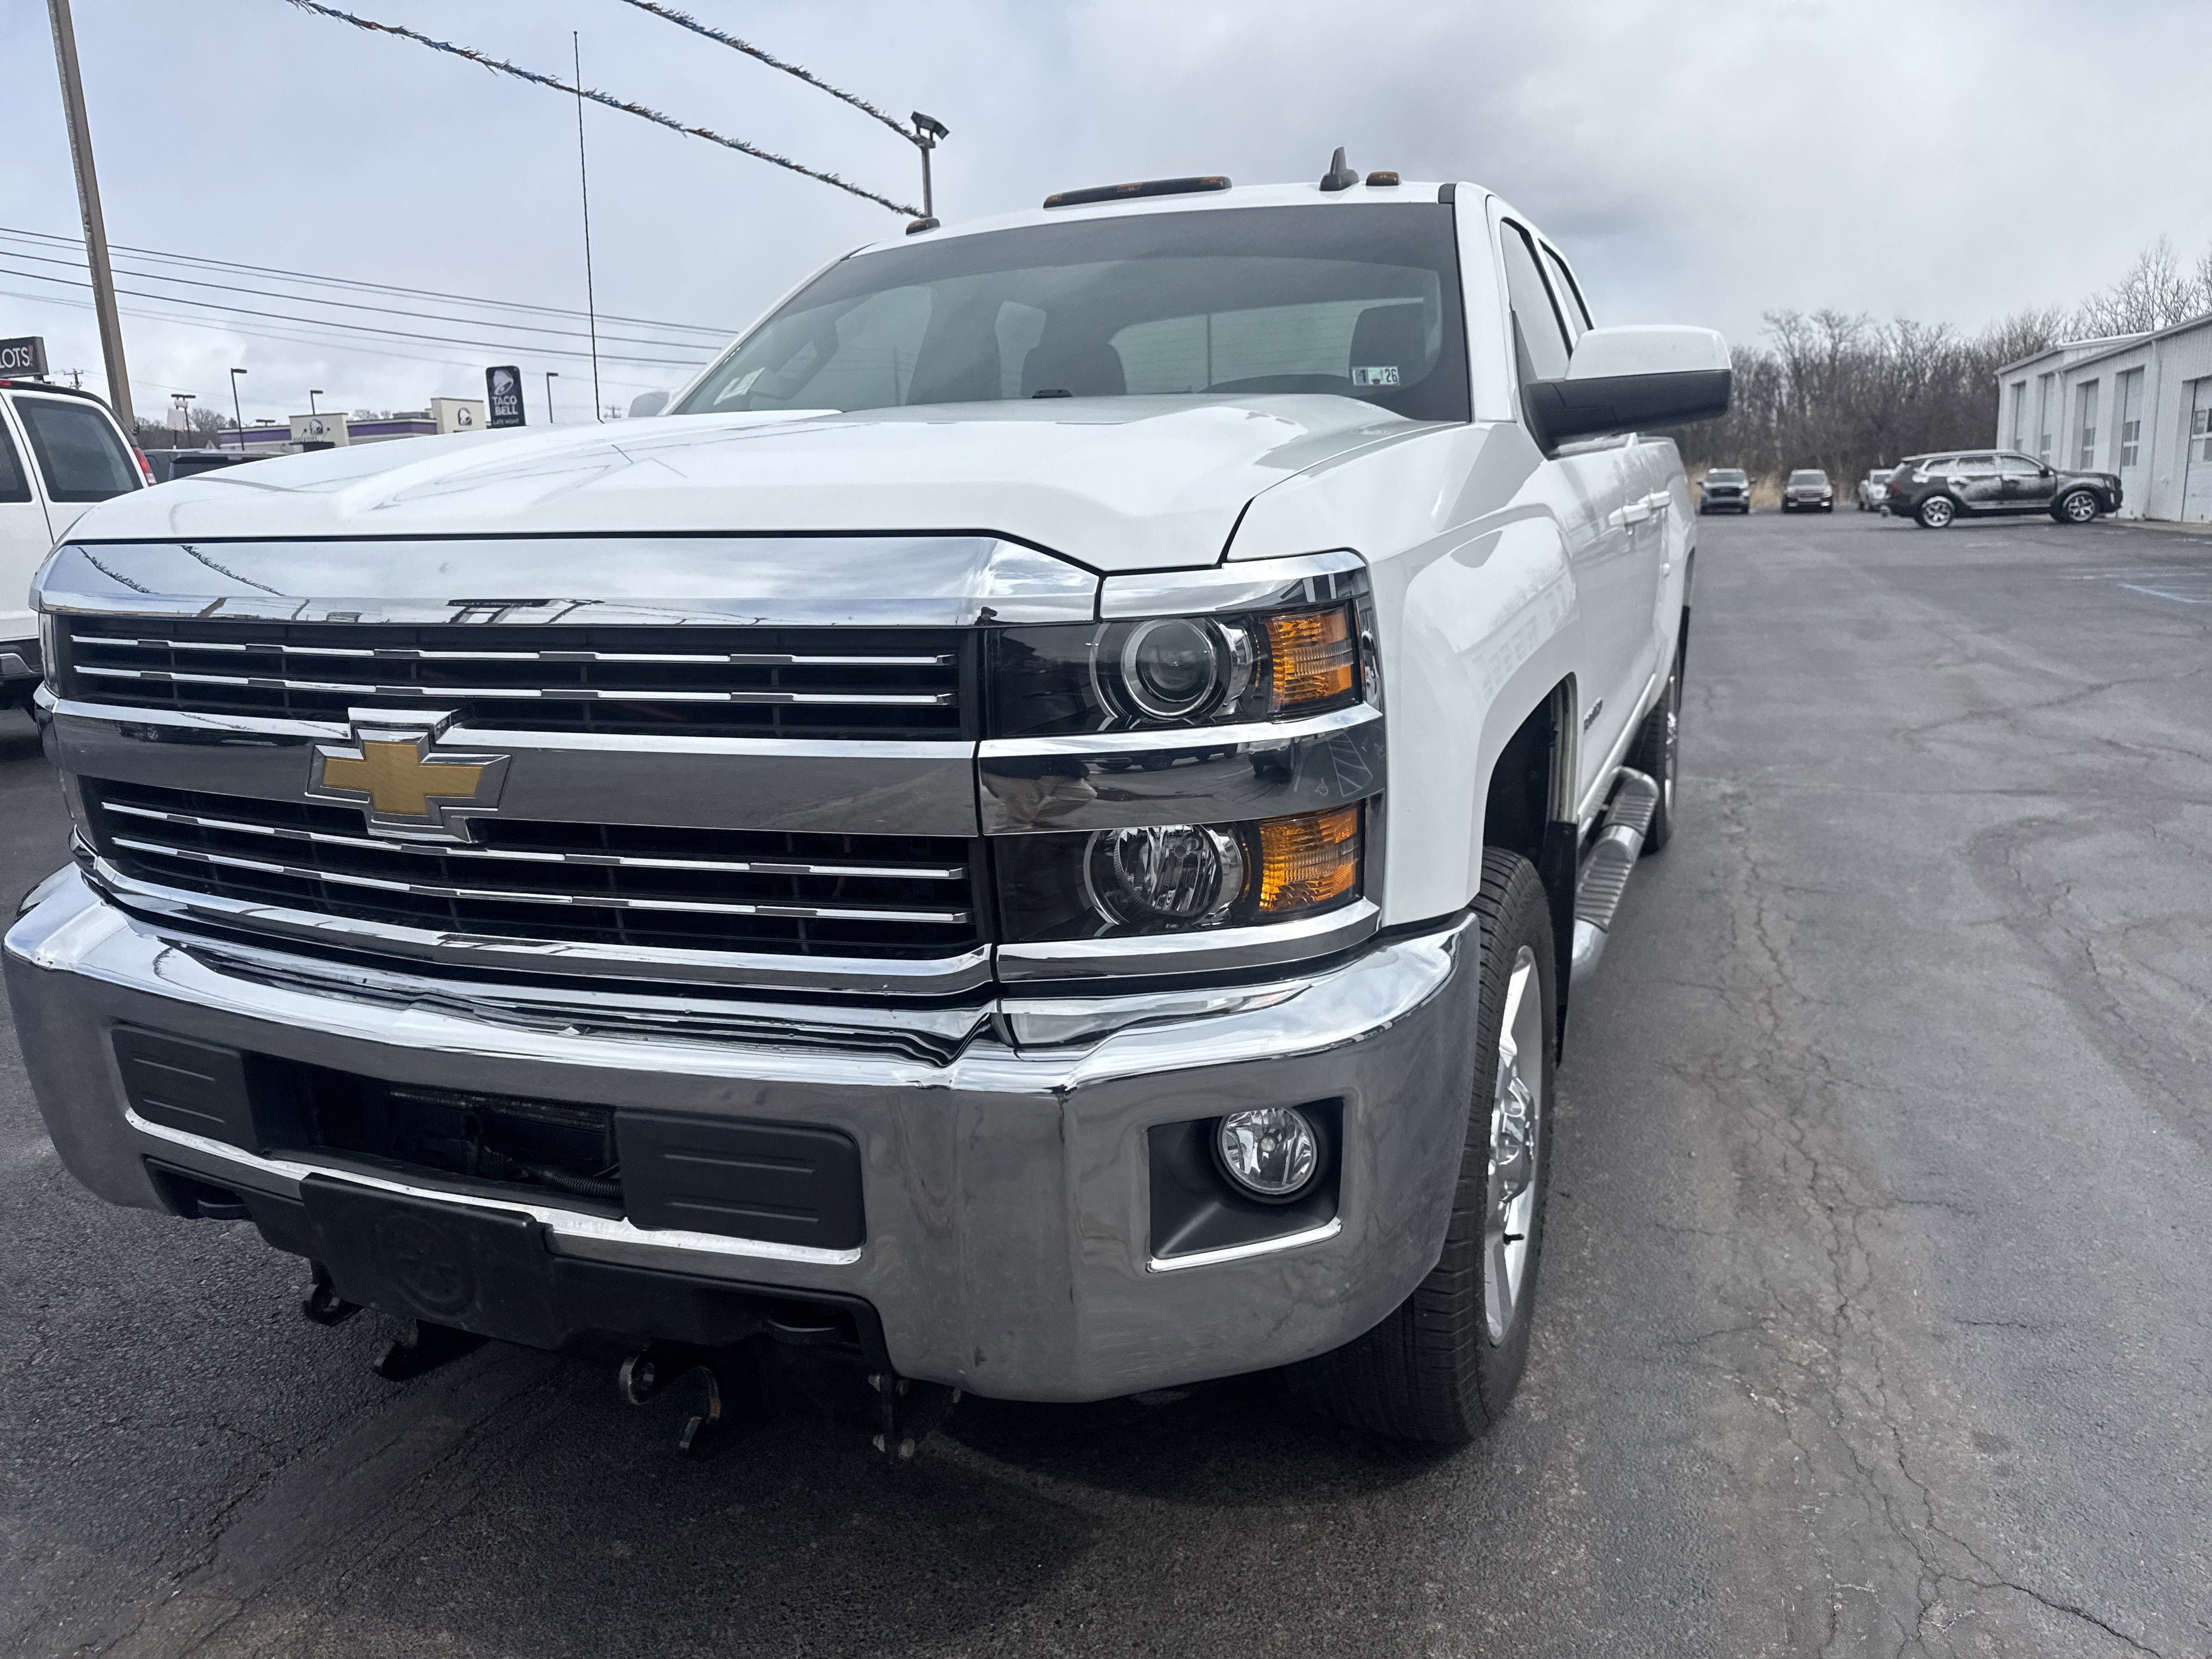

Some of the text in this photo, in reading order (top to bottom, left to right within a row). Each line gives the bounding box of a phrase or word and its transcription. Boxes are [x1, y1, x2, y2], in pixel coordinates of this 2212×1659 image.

[1385, 368, 1397, 382] 26
[492, 395, 517, 406] TACO
[495, 405, 518, 416] BELL
